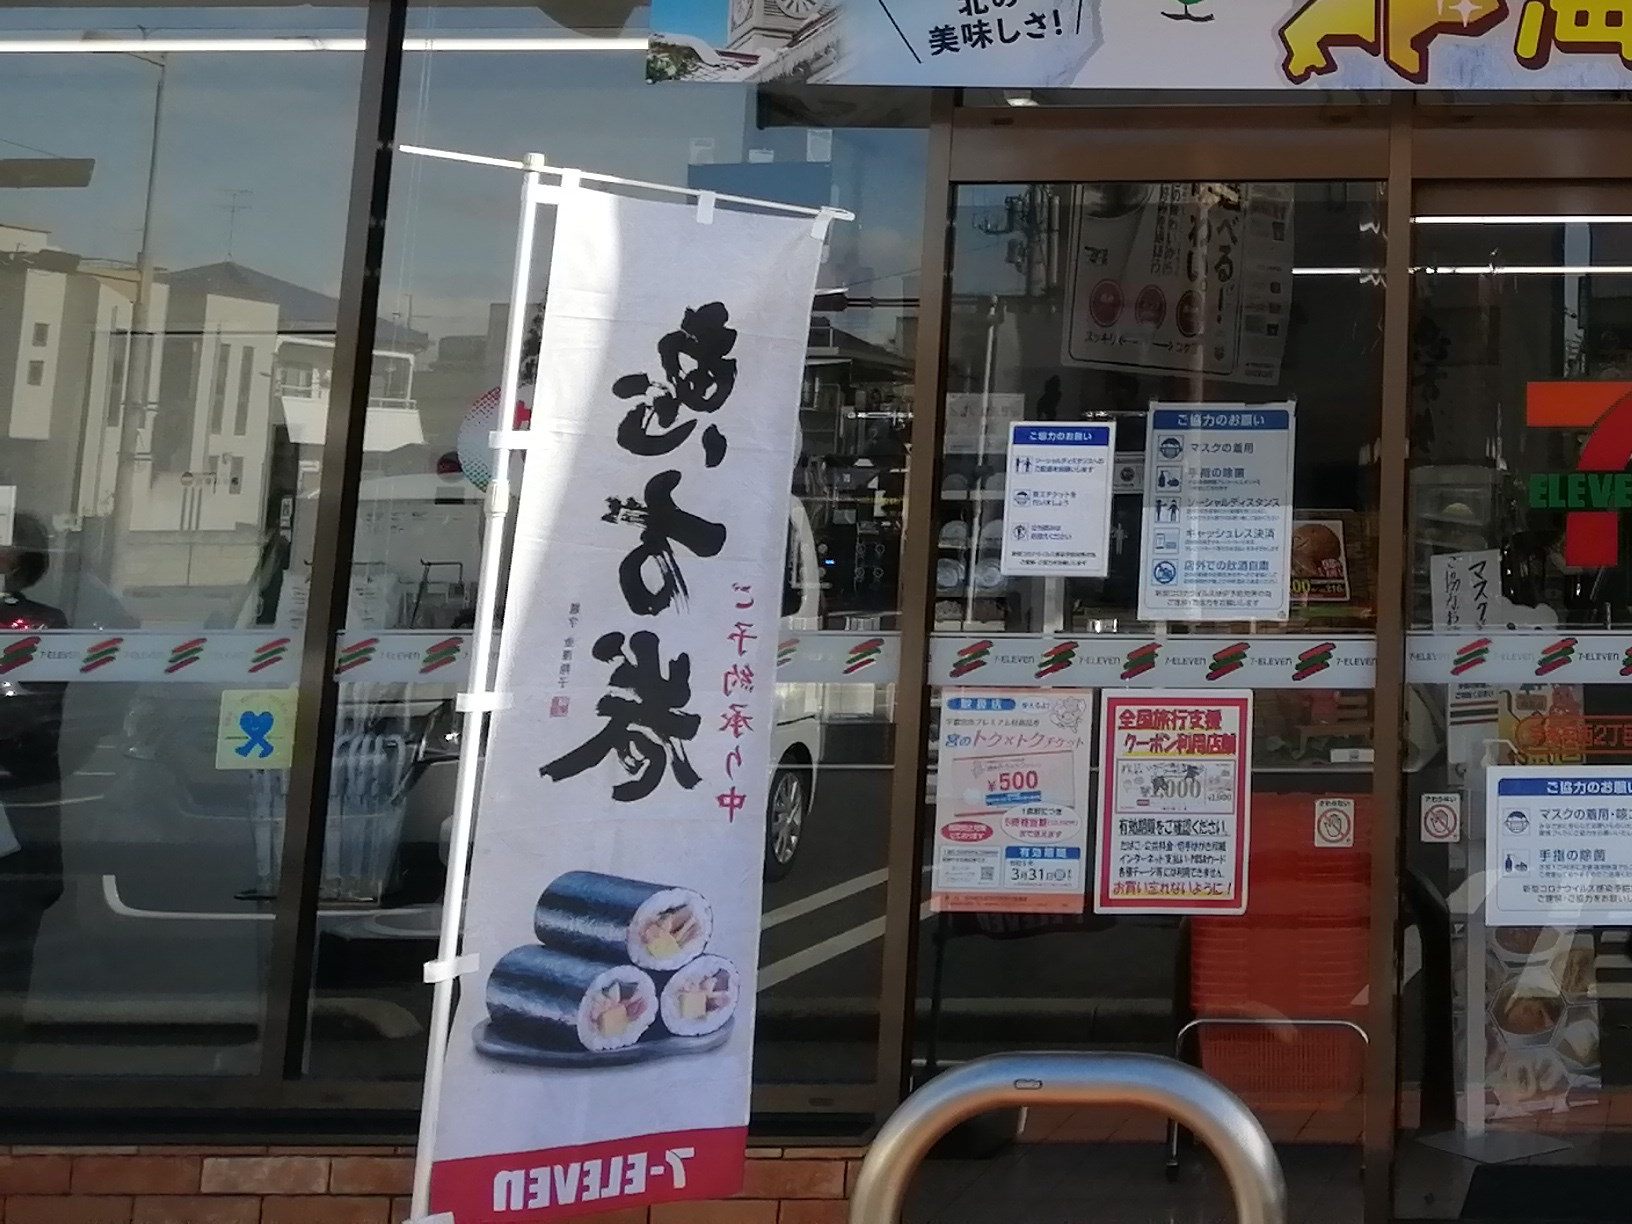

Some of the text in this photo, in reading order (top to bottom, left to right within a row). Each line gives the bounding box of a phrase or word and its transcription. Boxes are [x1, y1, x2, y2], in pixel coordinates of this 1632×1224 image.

[928, 16, 1064, 56] 美味しさ!
[1178, 414, 1265, 426] ご協力のお願い
[1190, 442, 1254, 454] マスクの着用
[1187, 467, 1245, 478] 手指の除菌
[1187, 497, 1280, 508] ソーシャルディスタンス
[1186, 528, 1275, 540] キャッシュレス決済
[1118, 709, 1223, 731] 全国旅行支援
[987, 771, 1039, 791] ¥500
[1539, 849, 1606, 862] 手指の除菌
